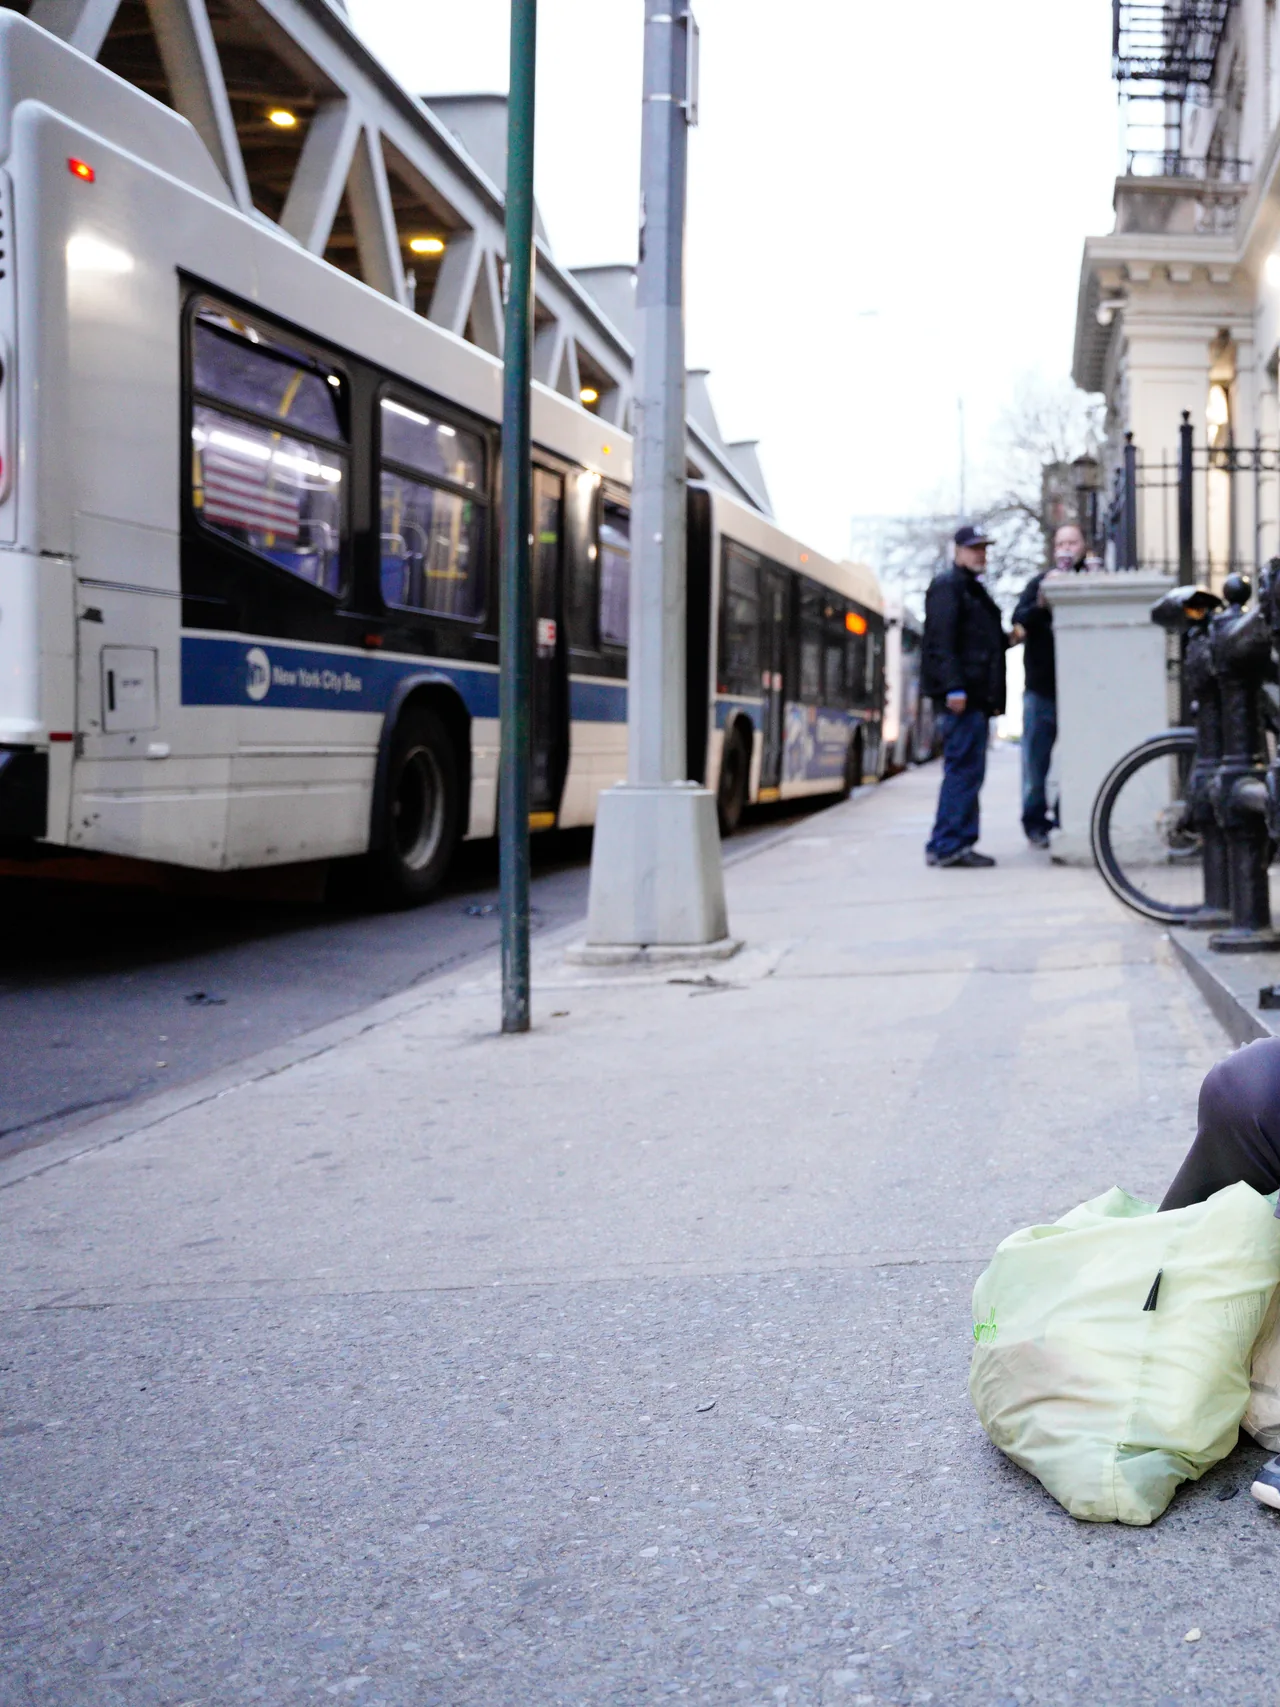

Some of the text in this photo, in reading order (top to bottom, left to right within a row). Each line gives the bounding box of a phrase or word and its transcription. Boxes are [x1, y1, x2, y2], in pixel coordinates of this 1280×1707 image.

[273, 666, 362, 694] New York City Bus
